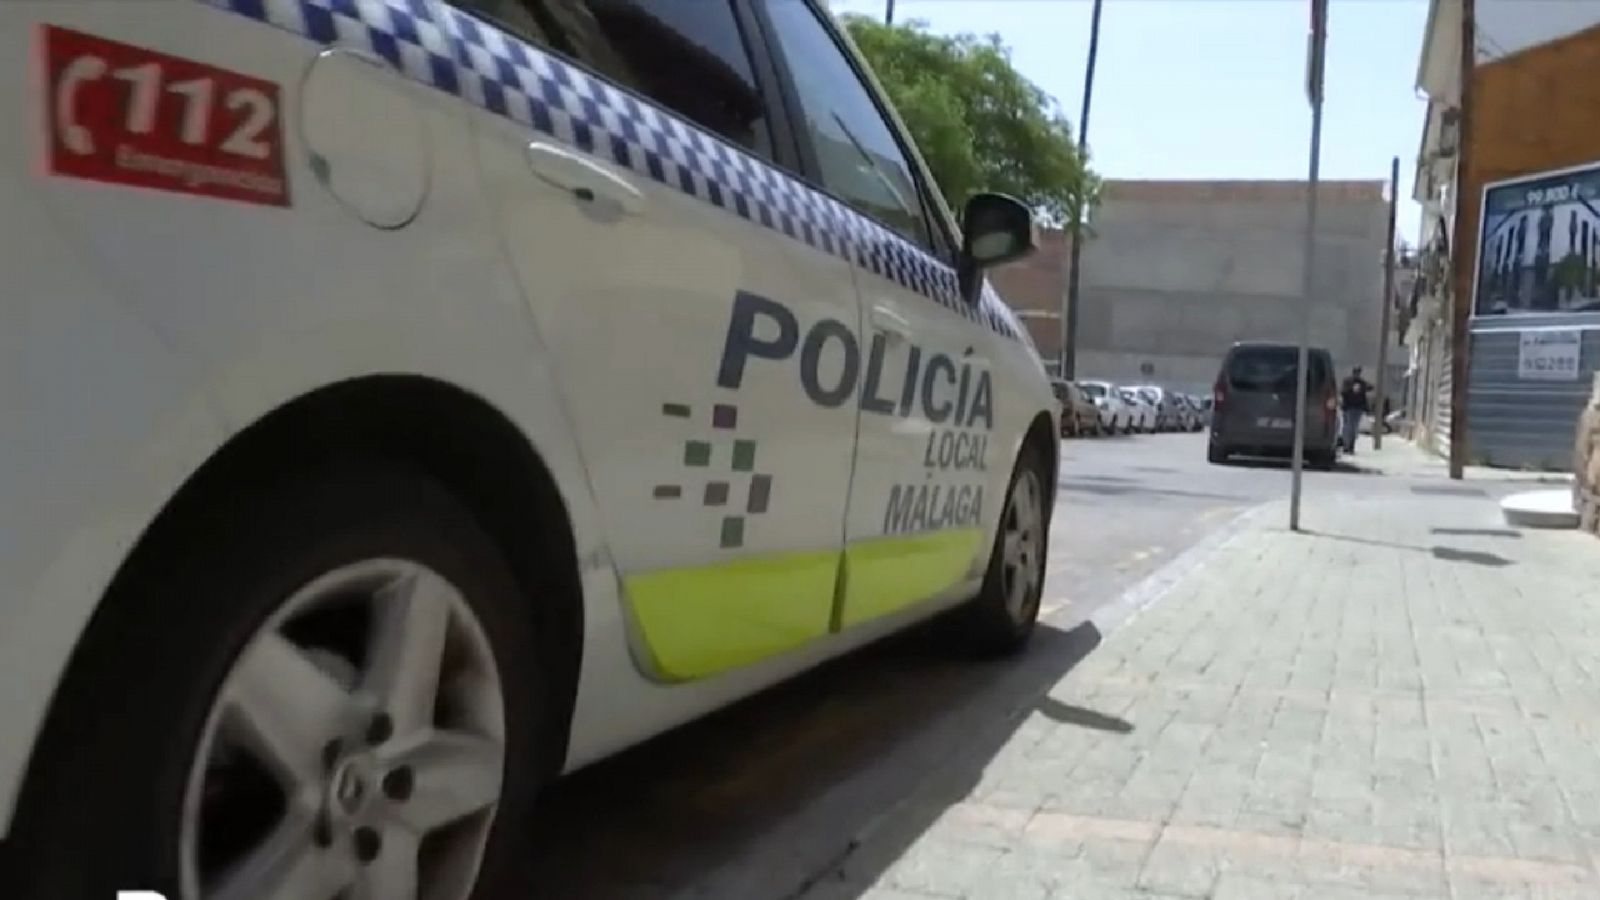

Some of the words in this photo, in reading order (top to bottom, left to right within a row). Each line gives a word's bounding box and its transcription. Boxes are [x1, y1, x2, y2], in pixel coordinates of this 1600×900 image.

[113, 62, 275, 160] 112
[717, 290, 993, 429] POLICÍA
[924, 431, 987, 471] LOCAL
[884, 473, 983, 534] MÁLAGA
